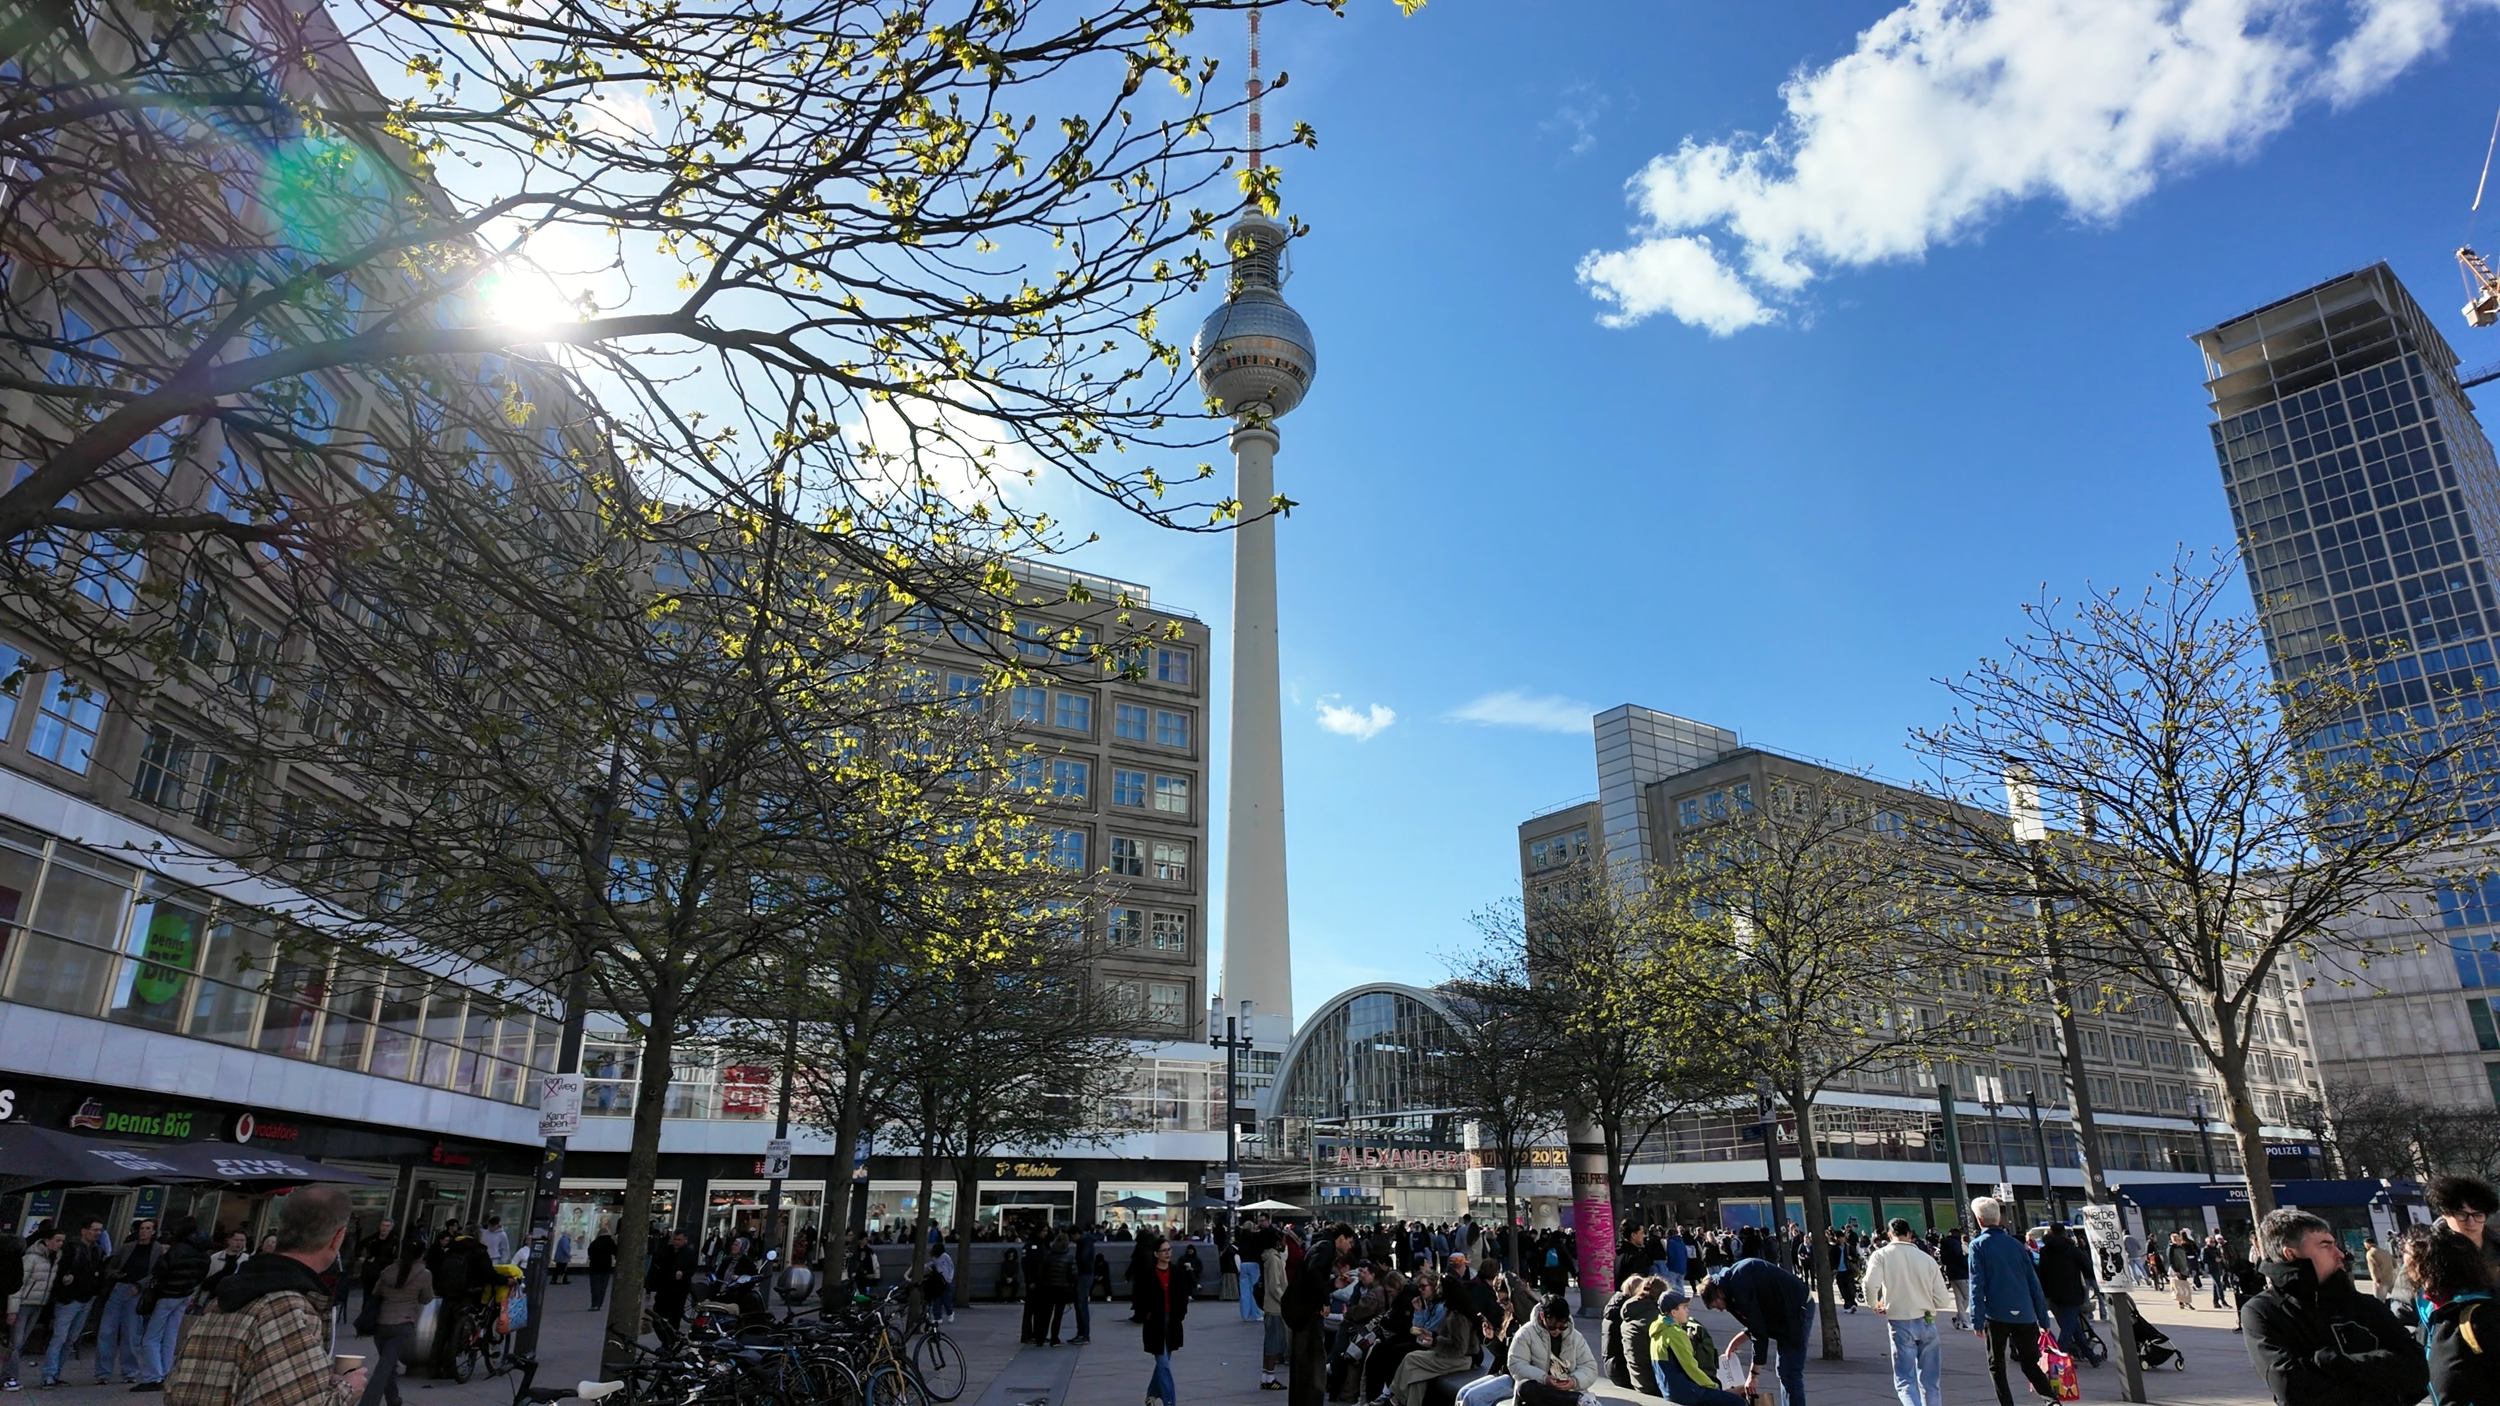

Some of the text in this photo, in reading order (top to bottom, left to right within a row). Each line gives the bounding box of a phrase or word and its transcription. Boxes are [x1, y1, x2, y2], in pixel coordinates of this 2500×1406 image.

[558, 1083, 577, 1093] weg
[254, 1122, 298, 1142] vodafone
[2265, 1145, 2301, 1156] POLIZEI
[1337, 1146, 1471, 1171] ALEXANDERP
[1532, 1150, 1550, 1163] 20
[1553, 1150, 1568, 1163] 21
[211, 1158, 289, 1168] FIVE
[216, 1167, 309, 1177] GUYS
[1014, 1161, 1062, 1178] Tchibo
[2229, 1190, 2248, 1198] POLI
[2105, 1229, 2120, 1241] ab
